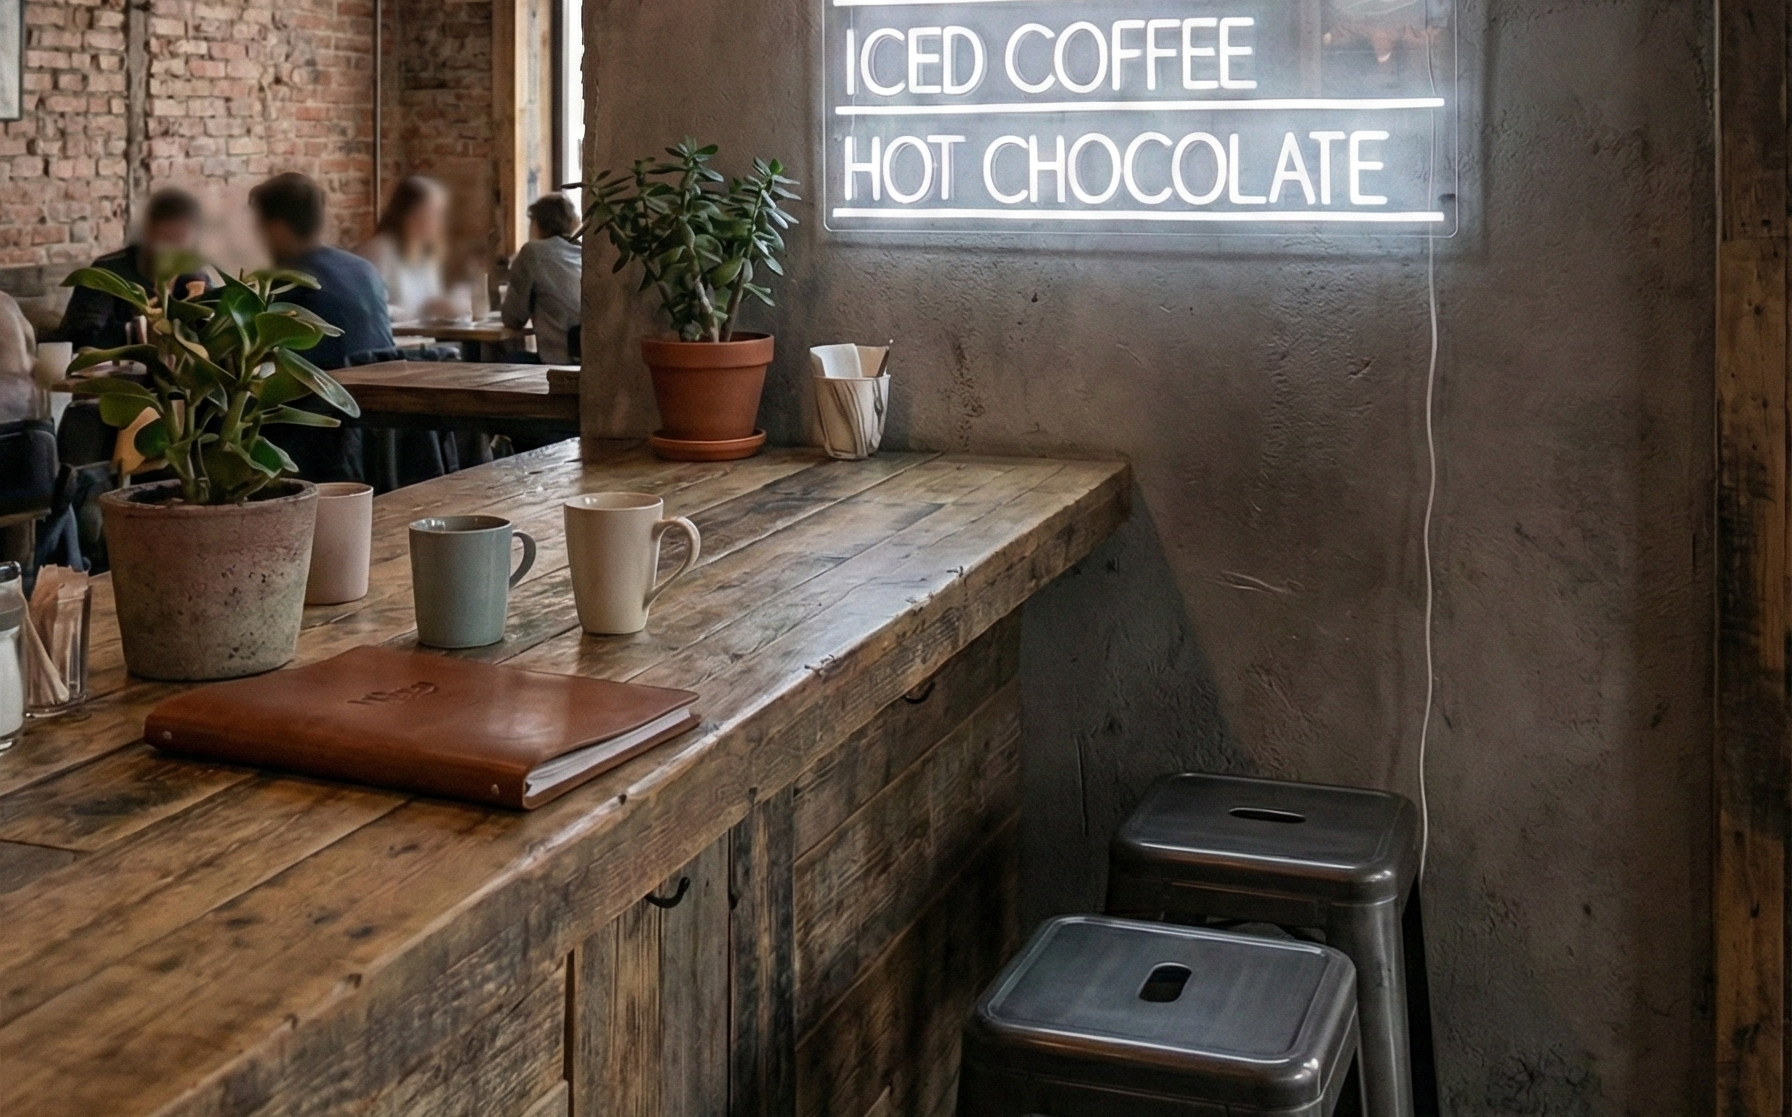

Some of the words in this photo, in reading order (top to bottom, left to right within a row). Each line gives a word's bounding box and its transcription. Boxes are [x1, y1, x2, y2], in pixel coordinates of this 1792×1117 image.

[846, 25, 984, 96] ICED
[1004, 16, 1257, 94] COFFEE
[844, 134, 966, 204] HOT
[982, 130, 1389, 205] CHOCOLATE
